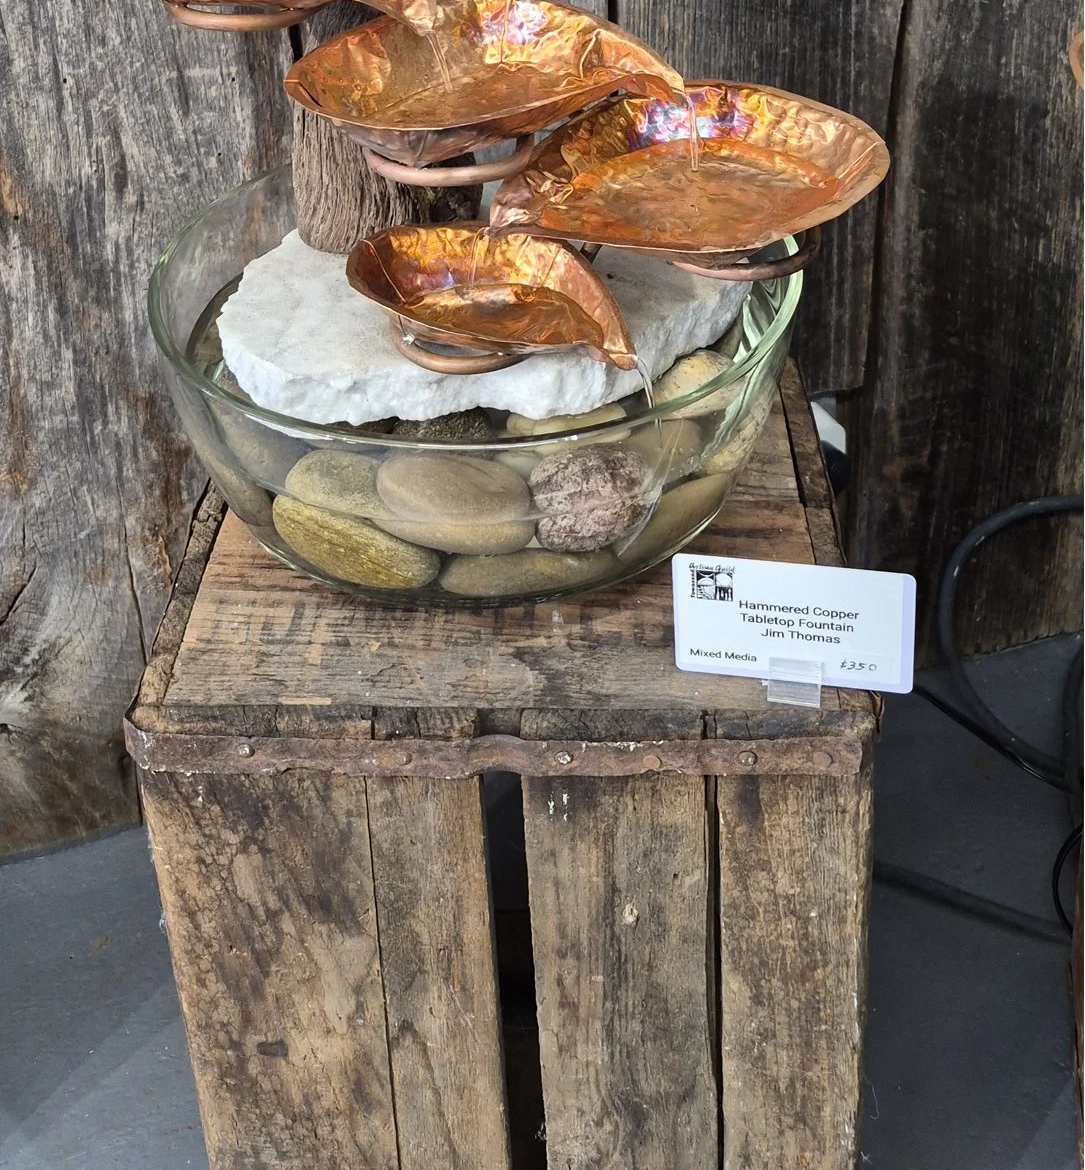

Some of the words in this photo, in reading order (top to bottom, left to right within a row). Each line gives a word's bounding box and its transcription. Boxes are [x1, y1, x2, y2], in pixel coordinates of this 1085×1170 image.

[739, 600, 809, 615] Hammered
[813, 607, 860, 620] Copper
[740, 612, 795, 628] Tabletop
[799, 619, 854, 632] Fountain
[761, 629, 785, 638] Jim
[788, 630, 841, 644] Thomas
[690, 648, 722, 658] Mixed
[725, 651, 757, 662] Media
